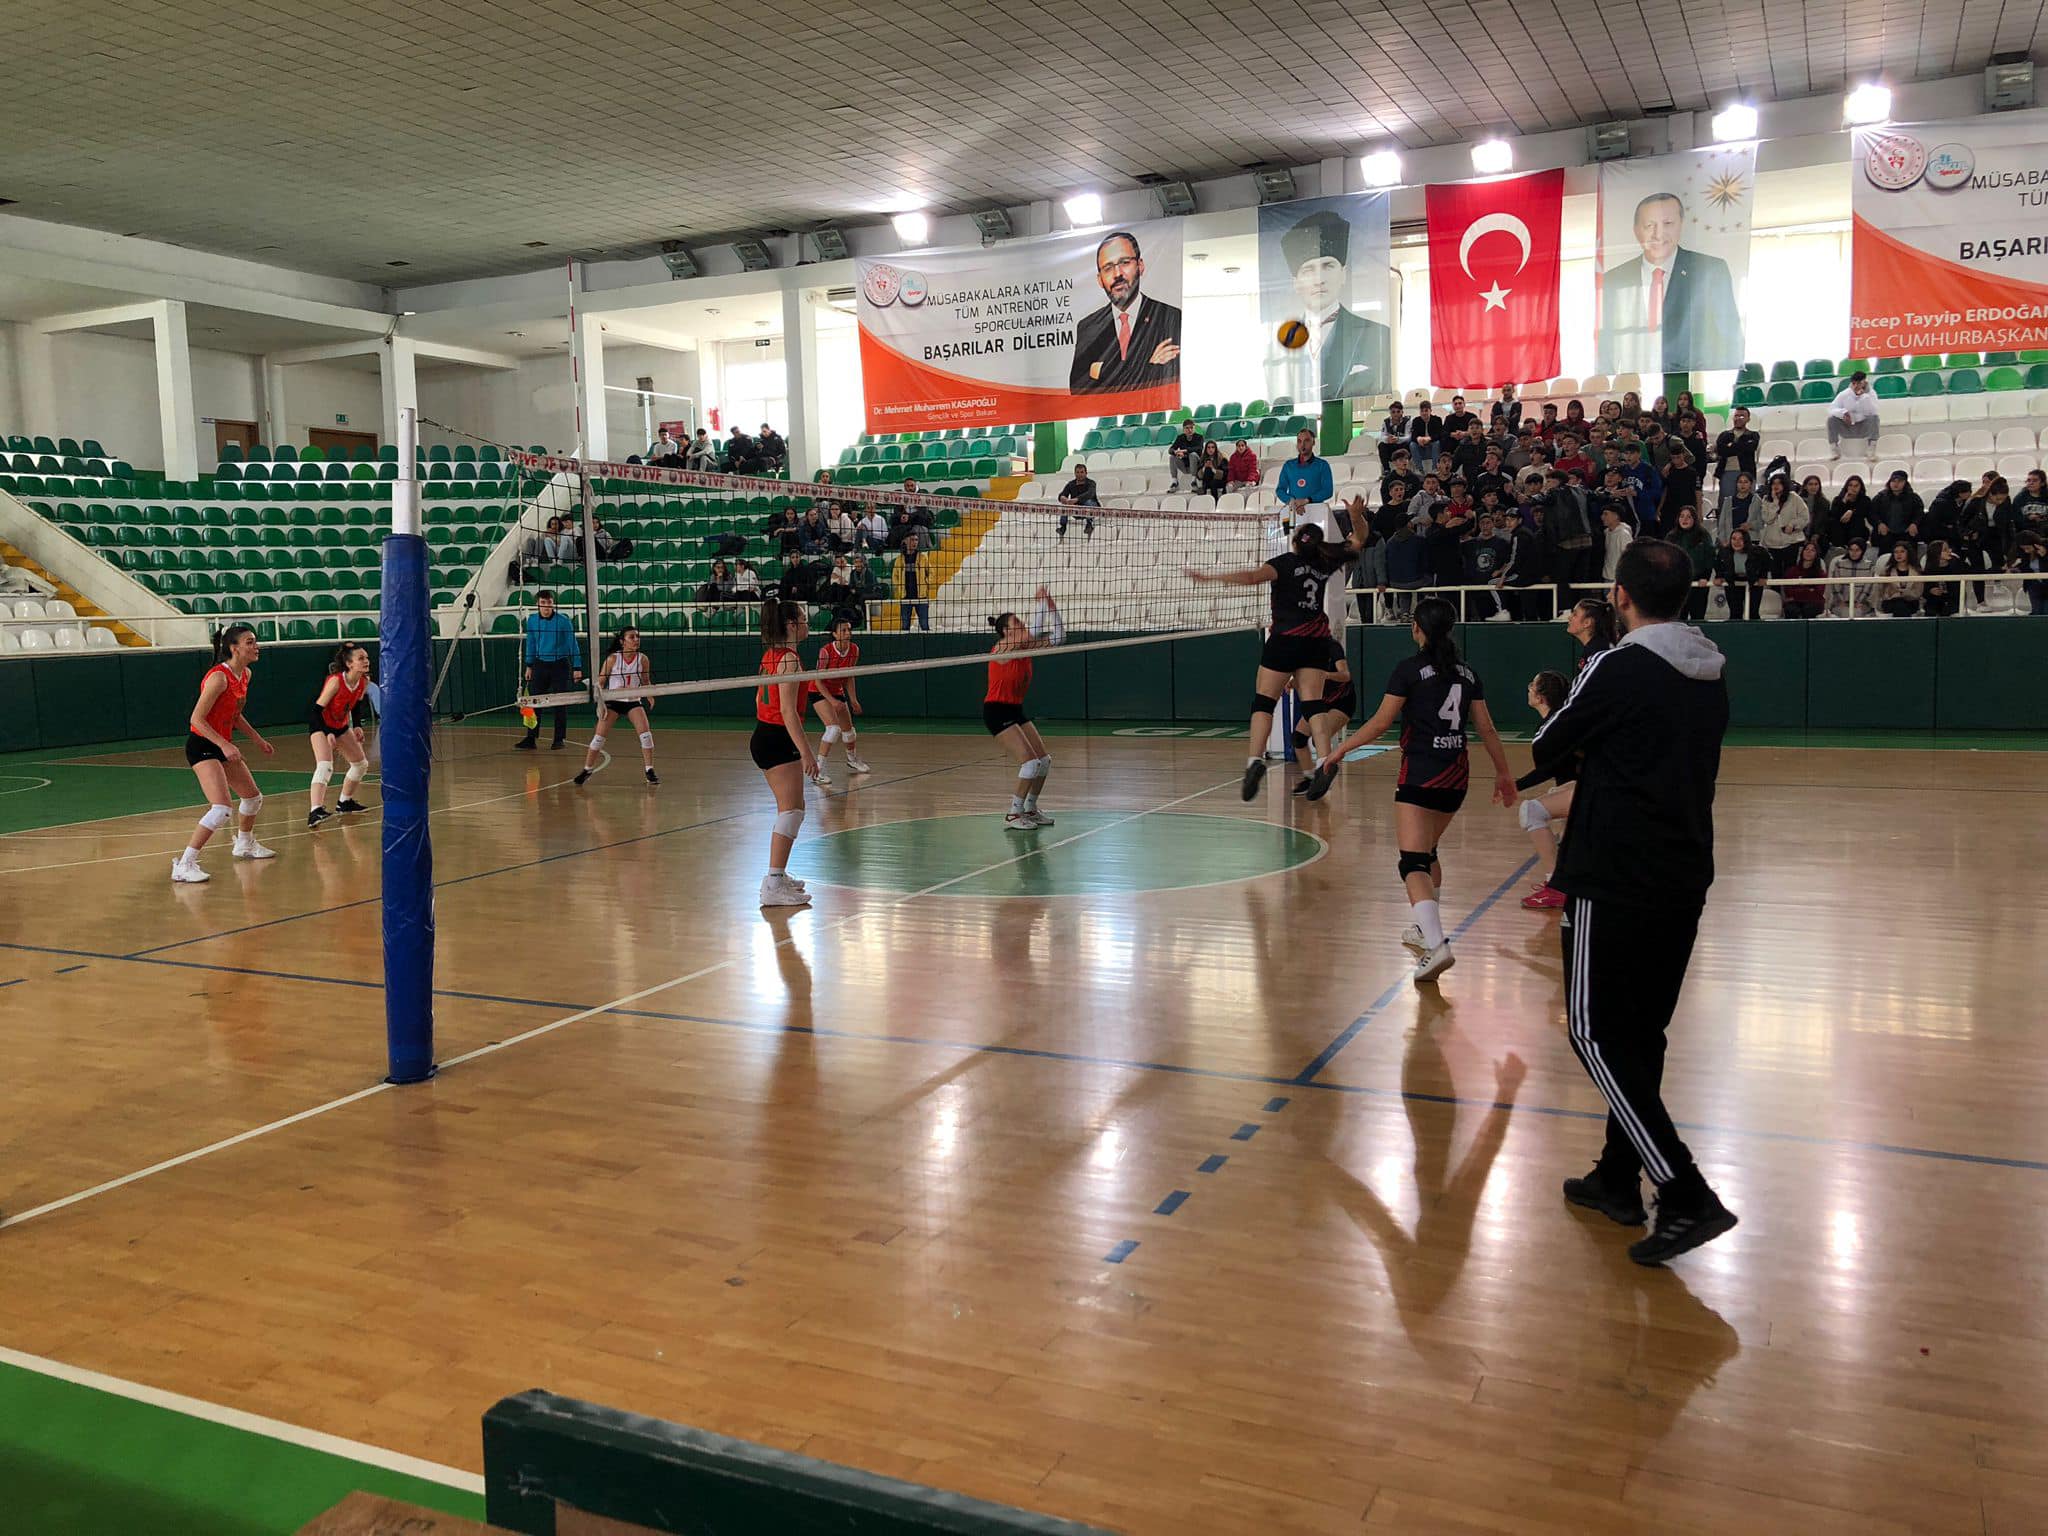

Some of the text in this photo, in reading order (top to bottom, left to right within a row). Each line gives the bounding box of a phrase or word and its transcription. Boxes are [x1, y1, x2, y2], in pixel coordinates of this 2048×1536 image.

[926, 278, 1073, 307] MÜSABAKALARA KATILAN
[954, 296, 1070, 320] TÜM ANTRENÖR VE
[1851, 316, 1900, 330] Recep
[1903, 310, 1961, 328] Tayyip
[974, 311, 1073, 334] SPORCULARIMIZA
[924, 328, 1074, 361] BAŞARILAR DİLERİM
[1886, 327, 2048, 349] CUMHURBAŞKAN
[873, 397, 997, 416] Dr. Mehmet Muharrem KASAPOĞLU
[609, 463, 630, 478] TVF
[641, 466, 662, 481] TVF
[677, 471, 697, 485] TVF
[704, 474, 725, 487] TVF
[738, 478, 757, 491] TVF
[765, 480, 782, 493] TVF
[1303, 578, 1319, 605] 3
[1438, 683, 1462, 731] 4
